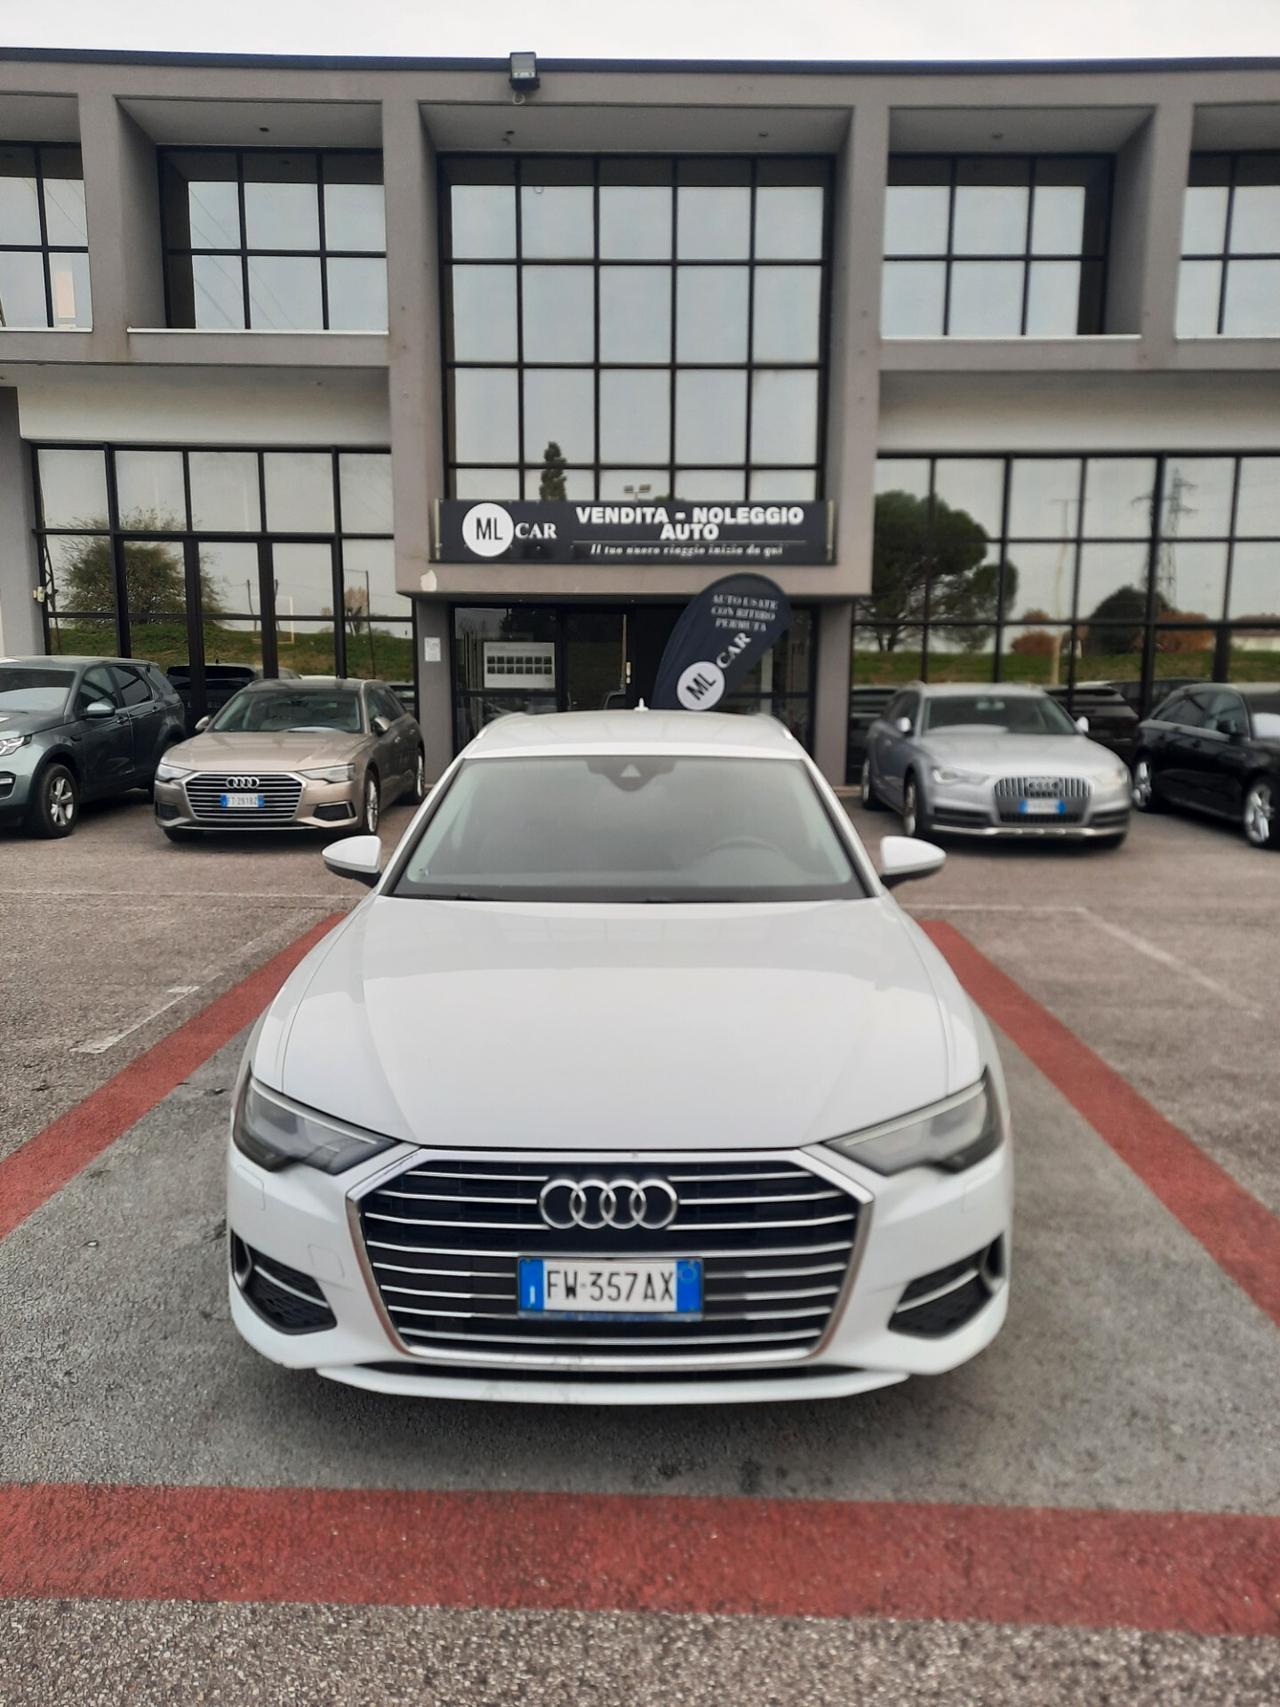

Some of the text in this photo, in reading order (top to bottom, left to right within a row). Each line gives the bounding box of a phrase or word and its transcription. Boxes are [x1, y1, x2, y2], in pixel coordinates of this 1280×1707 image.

[575, 507, 669, 524] VENDITA
[693, 507, 804, 525] NOLEGGIO
[476, 517, 557, 540] ML CAR
[660, 524, 719, 540] AUTO
[604, 545, 623, 555] tuo
[663, 544, 705, 557] viaggio
[708, 544, 744, 555] inizia
[745, 544, 761, 555] da
[765, 545, 783, 557] qui
[713, 594, 742, 606] AUTO
[711, 605, 735, 617] CON
[715, 617, 767, 632] PERMUTA
[686, 632, 751, 701] ML CAR
